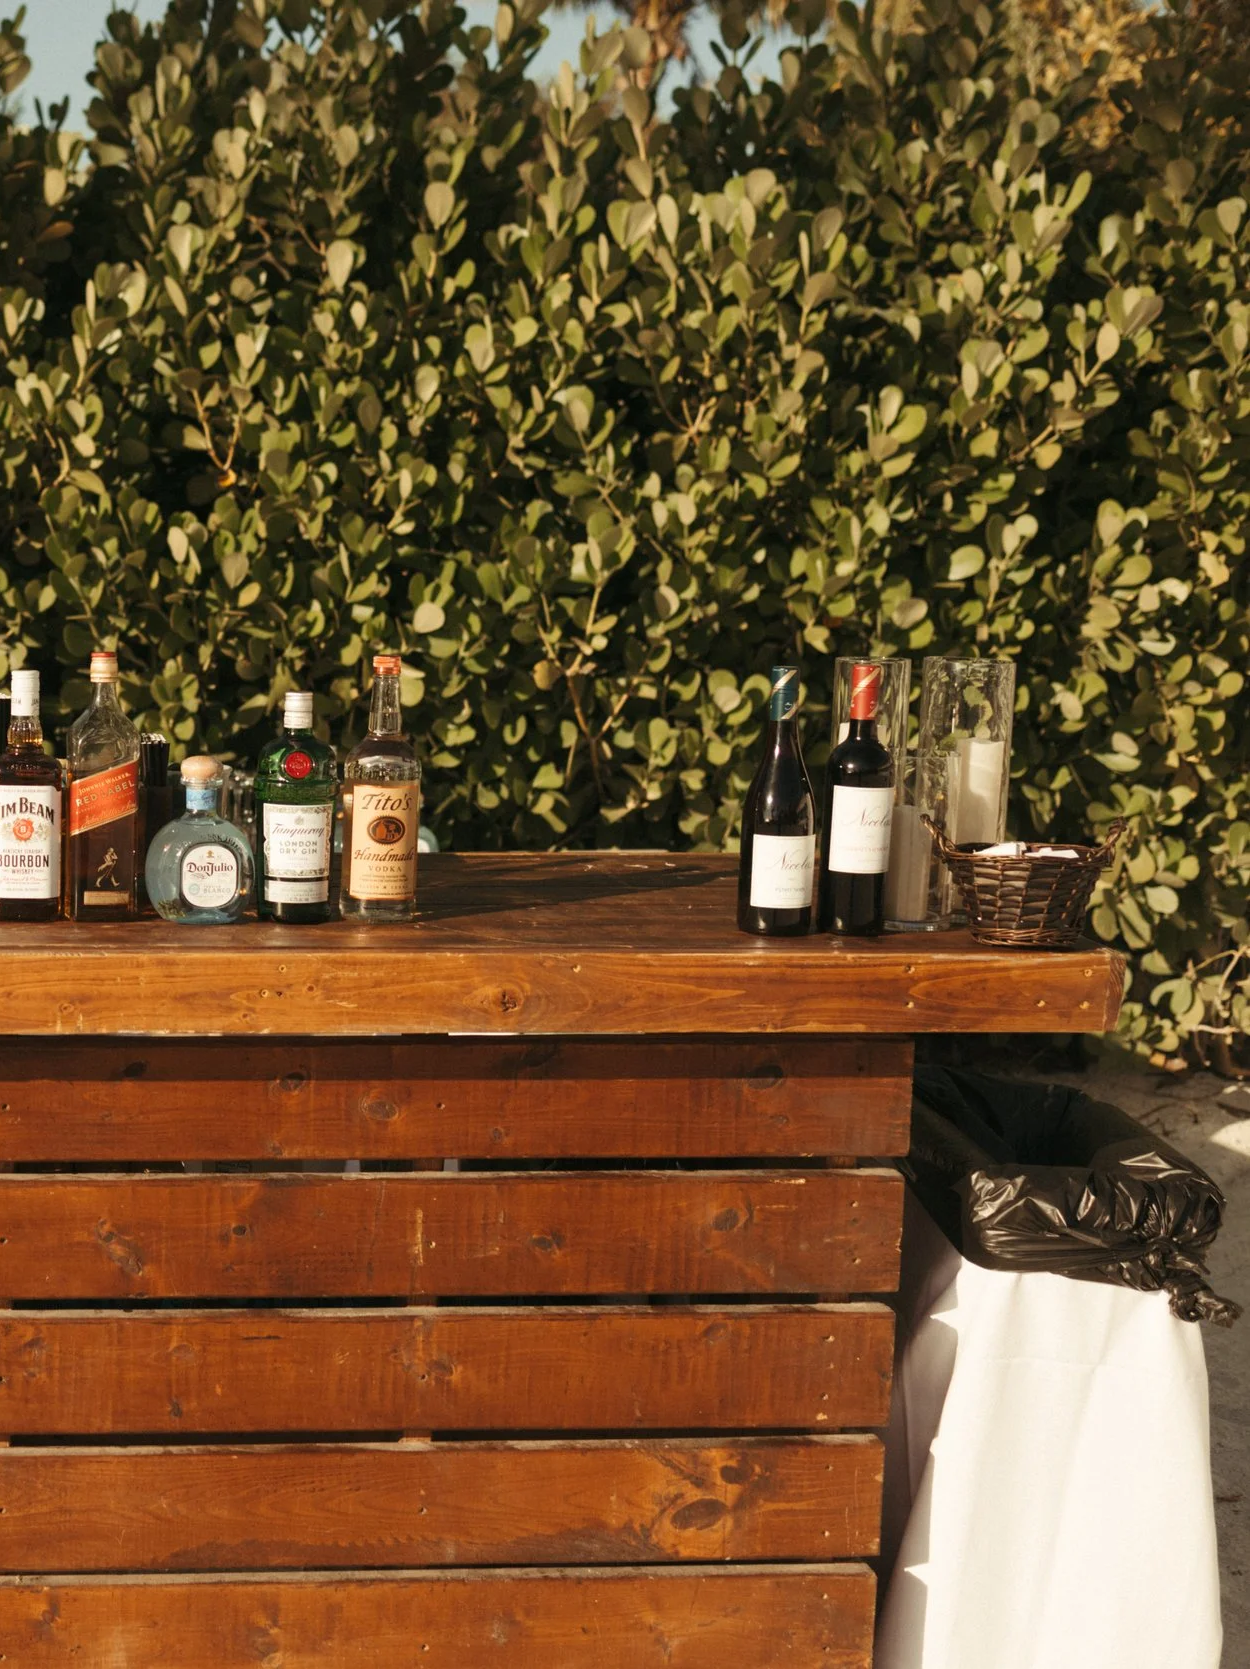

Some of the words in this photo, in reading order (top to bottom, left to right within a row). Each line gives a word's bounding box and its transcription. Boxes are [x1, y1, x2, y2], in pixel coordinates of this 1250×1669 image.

[75, 793, 98, 807] RED
[101, 780, 135, 800] LABEL
[79, 782, 105, 796] JOHNNIE
[361, 792, 413, 811] Tito's
[19, 797, 55, 826] BEAM
[272, 822, 325, 838] Tanqueray
[279, 840, 318, 848] LONDON
[280, 847, 297, 855] DRY
[186, 861, 209, 873] Don
[206, 861, 234, 877] Julio
[368, 865, 402, 873] VODKA
